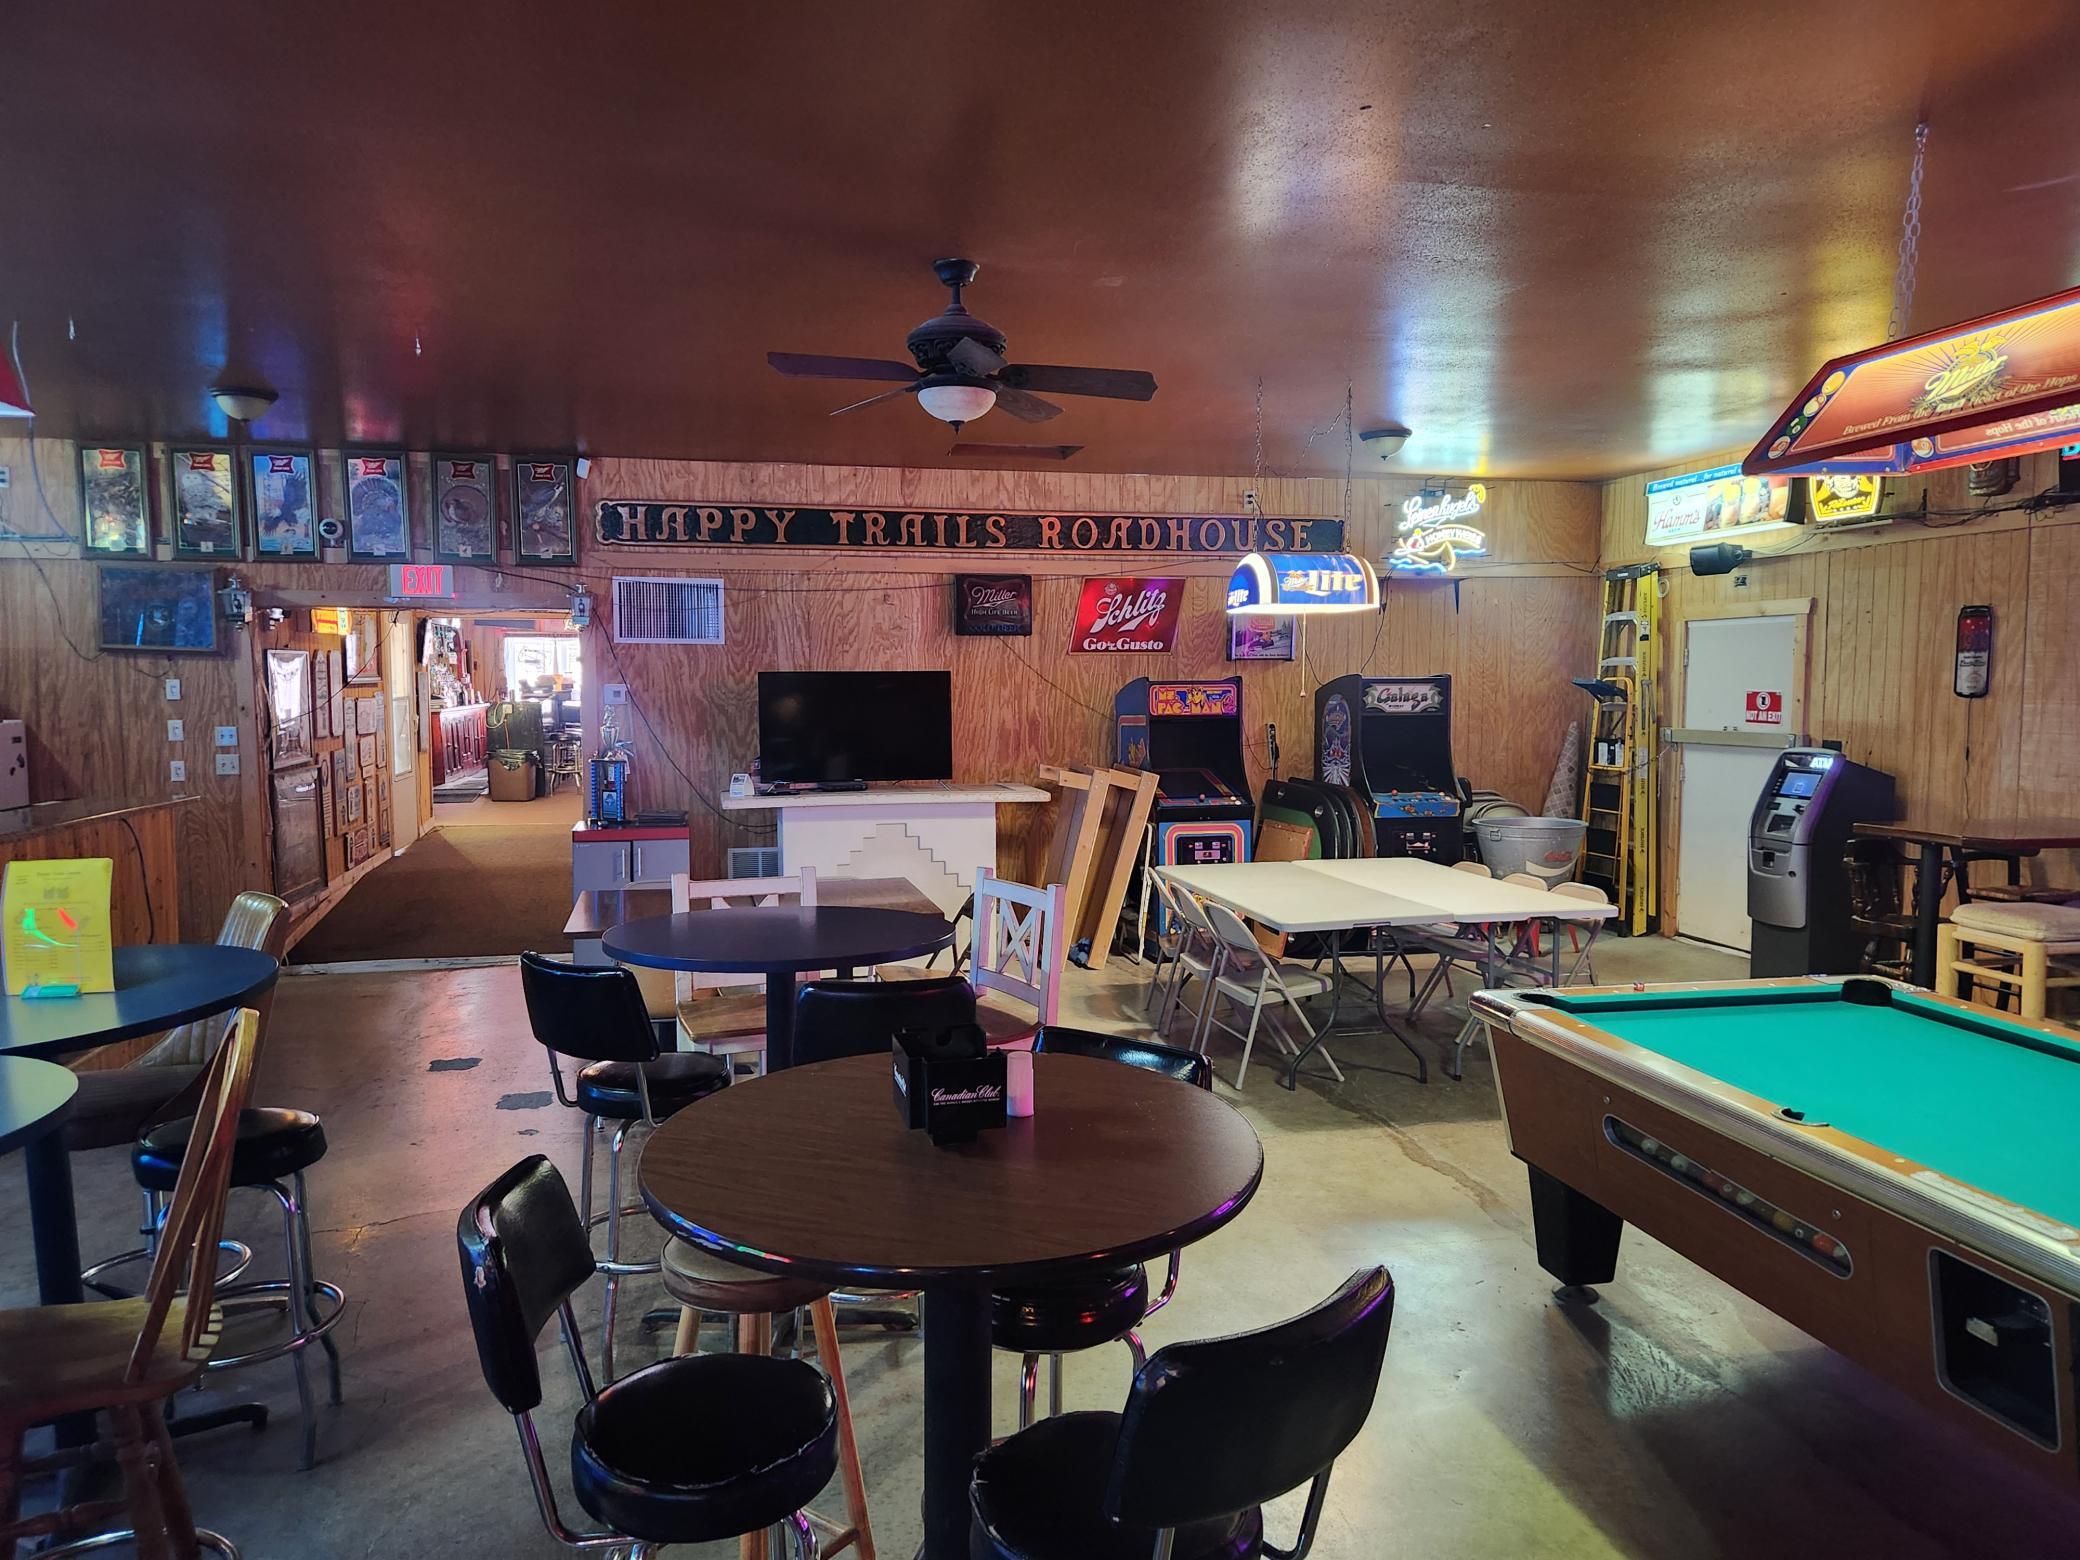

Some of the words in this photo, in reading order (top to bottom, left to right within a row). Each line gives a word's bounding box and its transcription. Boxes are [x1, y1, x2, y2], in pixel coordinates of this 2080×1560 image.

[1843, 417, 1882, 435] Brewed
[1882, 410, 1912, 426] From
[2020, 381, 2042, 394] the
[2043, 374, 2077, 390] Hops
[617, 505, 797, 544] HAPPY
[829, 511, 1007, 548] TRAILS
[1038, 516, 1314, 551] ROADHOUSE
[1653, 508, 1701, 530] Hamm's
[402, 566, 443, 594] EXIT
[1305, 570, 1363, 596] Lite
[971, 586, 1017, 606] Miller
[1089, 588, 1167, 633] Schlitz
[1083, 637, 1107, 650] Go
[1116, 637, 1164, 650] Gusto
[1377, 687, 1429, 711] Galaga
[1810, 757, 1833, 769] ATM
[931, 1088, 978, 1101] Canadian
[976, 1084, 1001, 1098] Club
